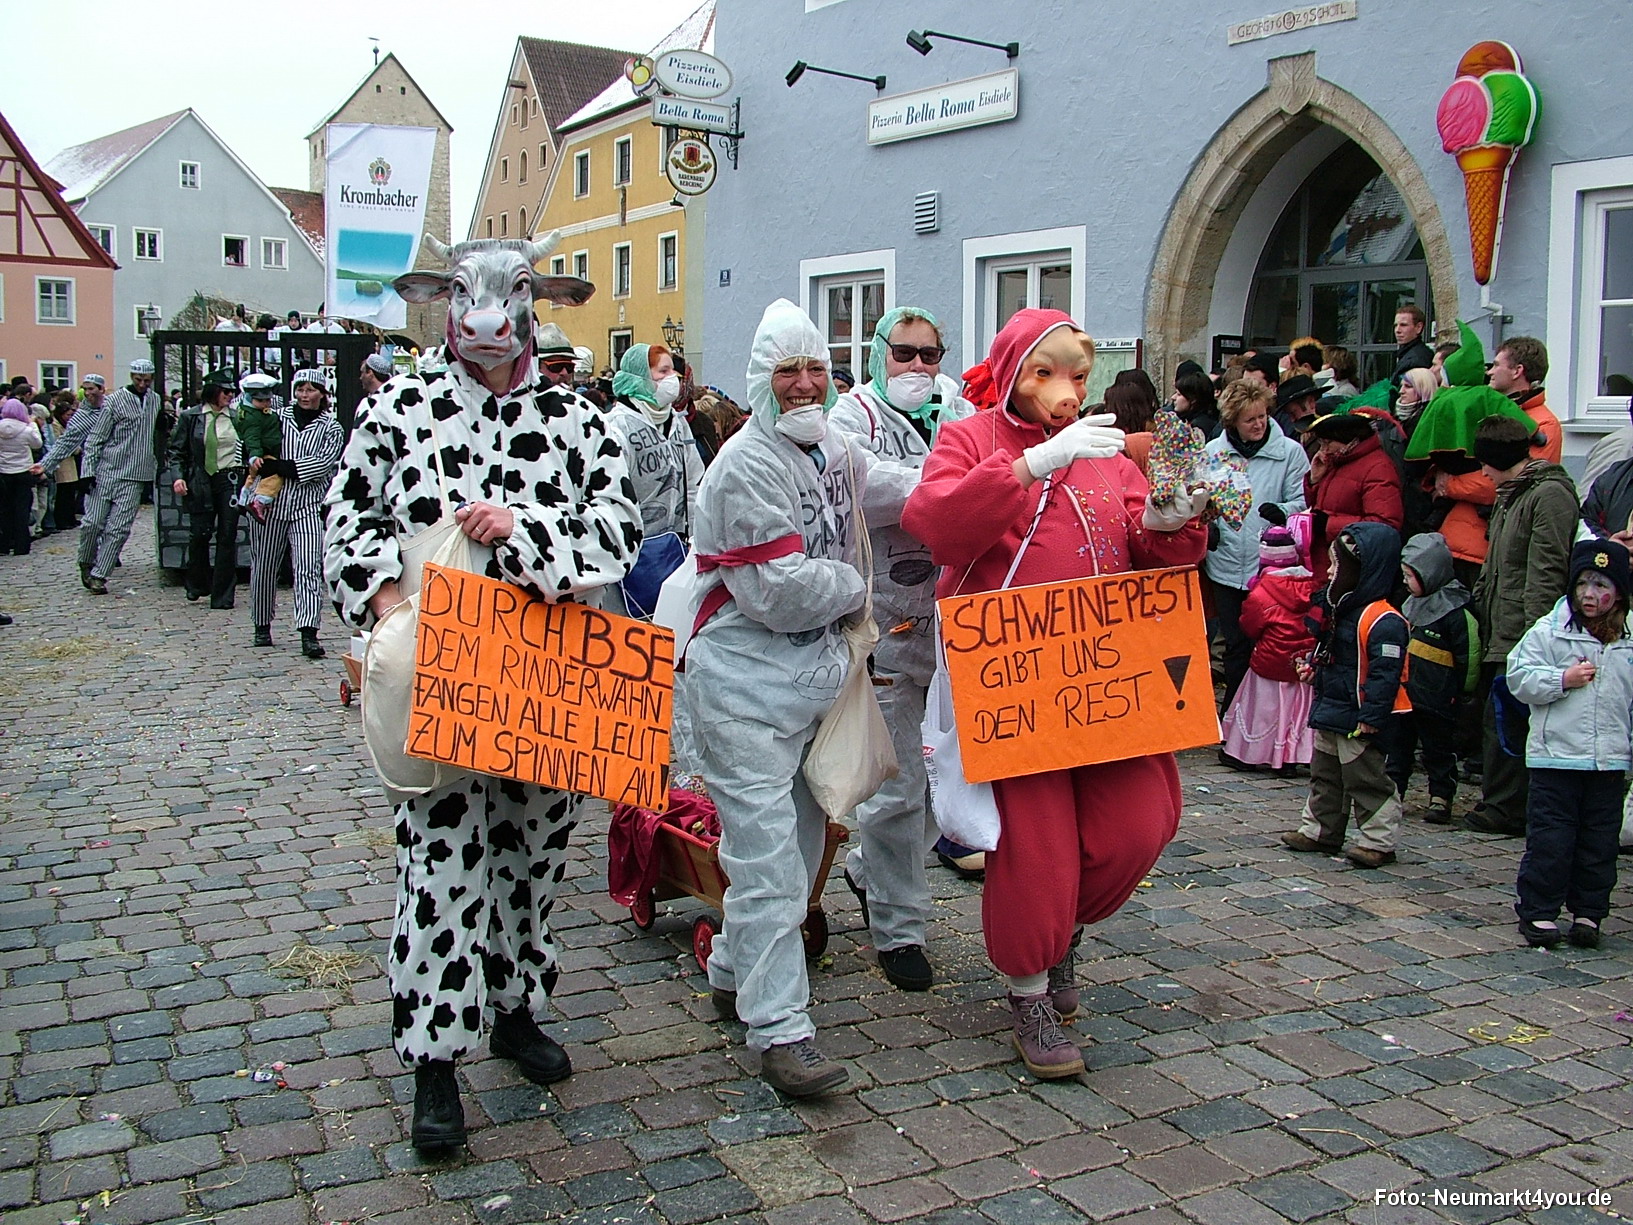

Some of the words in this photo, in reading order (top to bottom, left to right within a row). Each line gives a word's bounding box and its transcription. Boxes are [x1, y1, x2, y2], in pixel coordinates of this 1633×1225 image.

[668, 57, 715, 75] Pizzeria
[676, 72, 722, 90] Eisdiele
[659, 103, 688, 118] Bella
[692, 108, 724, 124] Roma
[871, 111, 902, 129] Pizzeria
[905, 102, 935, 126] Bella
[940, 98, 975, 118] Roma
[978, 87, 1012, 107] Eisdiele
[340, 185, 418, 207] Krombacher
[420, 567, 566, 657] DURCH
[569, 609, 675, 690] BSE
[946, 570, 1193, 653] SCHWEINEPEST
[416, 622, 480, 678] DEM
[500, 645, 663, 723] RINDERWAHN
[980, 647, 1044, 689] GIBT
[1061, 631, 1121, 678] UNS
[414, 671, 509, 726] FANGEN
[519, 696, 579, 744] ALLE
[592, 715, 668, 764] LEUT
[973, 700, 1035, 744] DEN
[1055, 671, 1152, 728] REST
[410, 711, 477, 768] ZUM
[488, 730, 607, 797] SPINNEN
[619, 764, 669, 811] AN!
